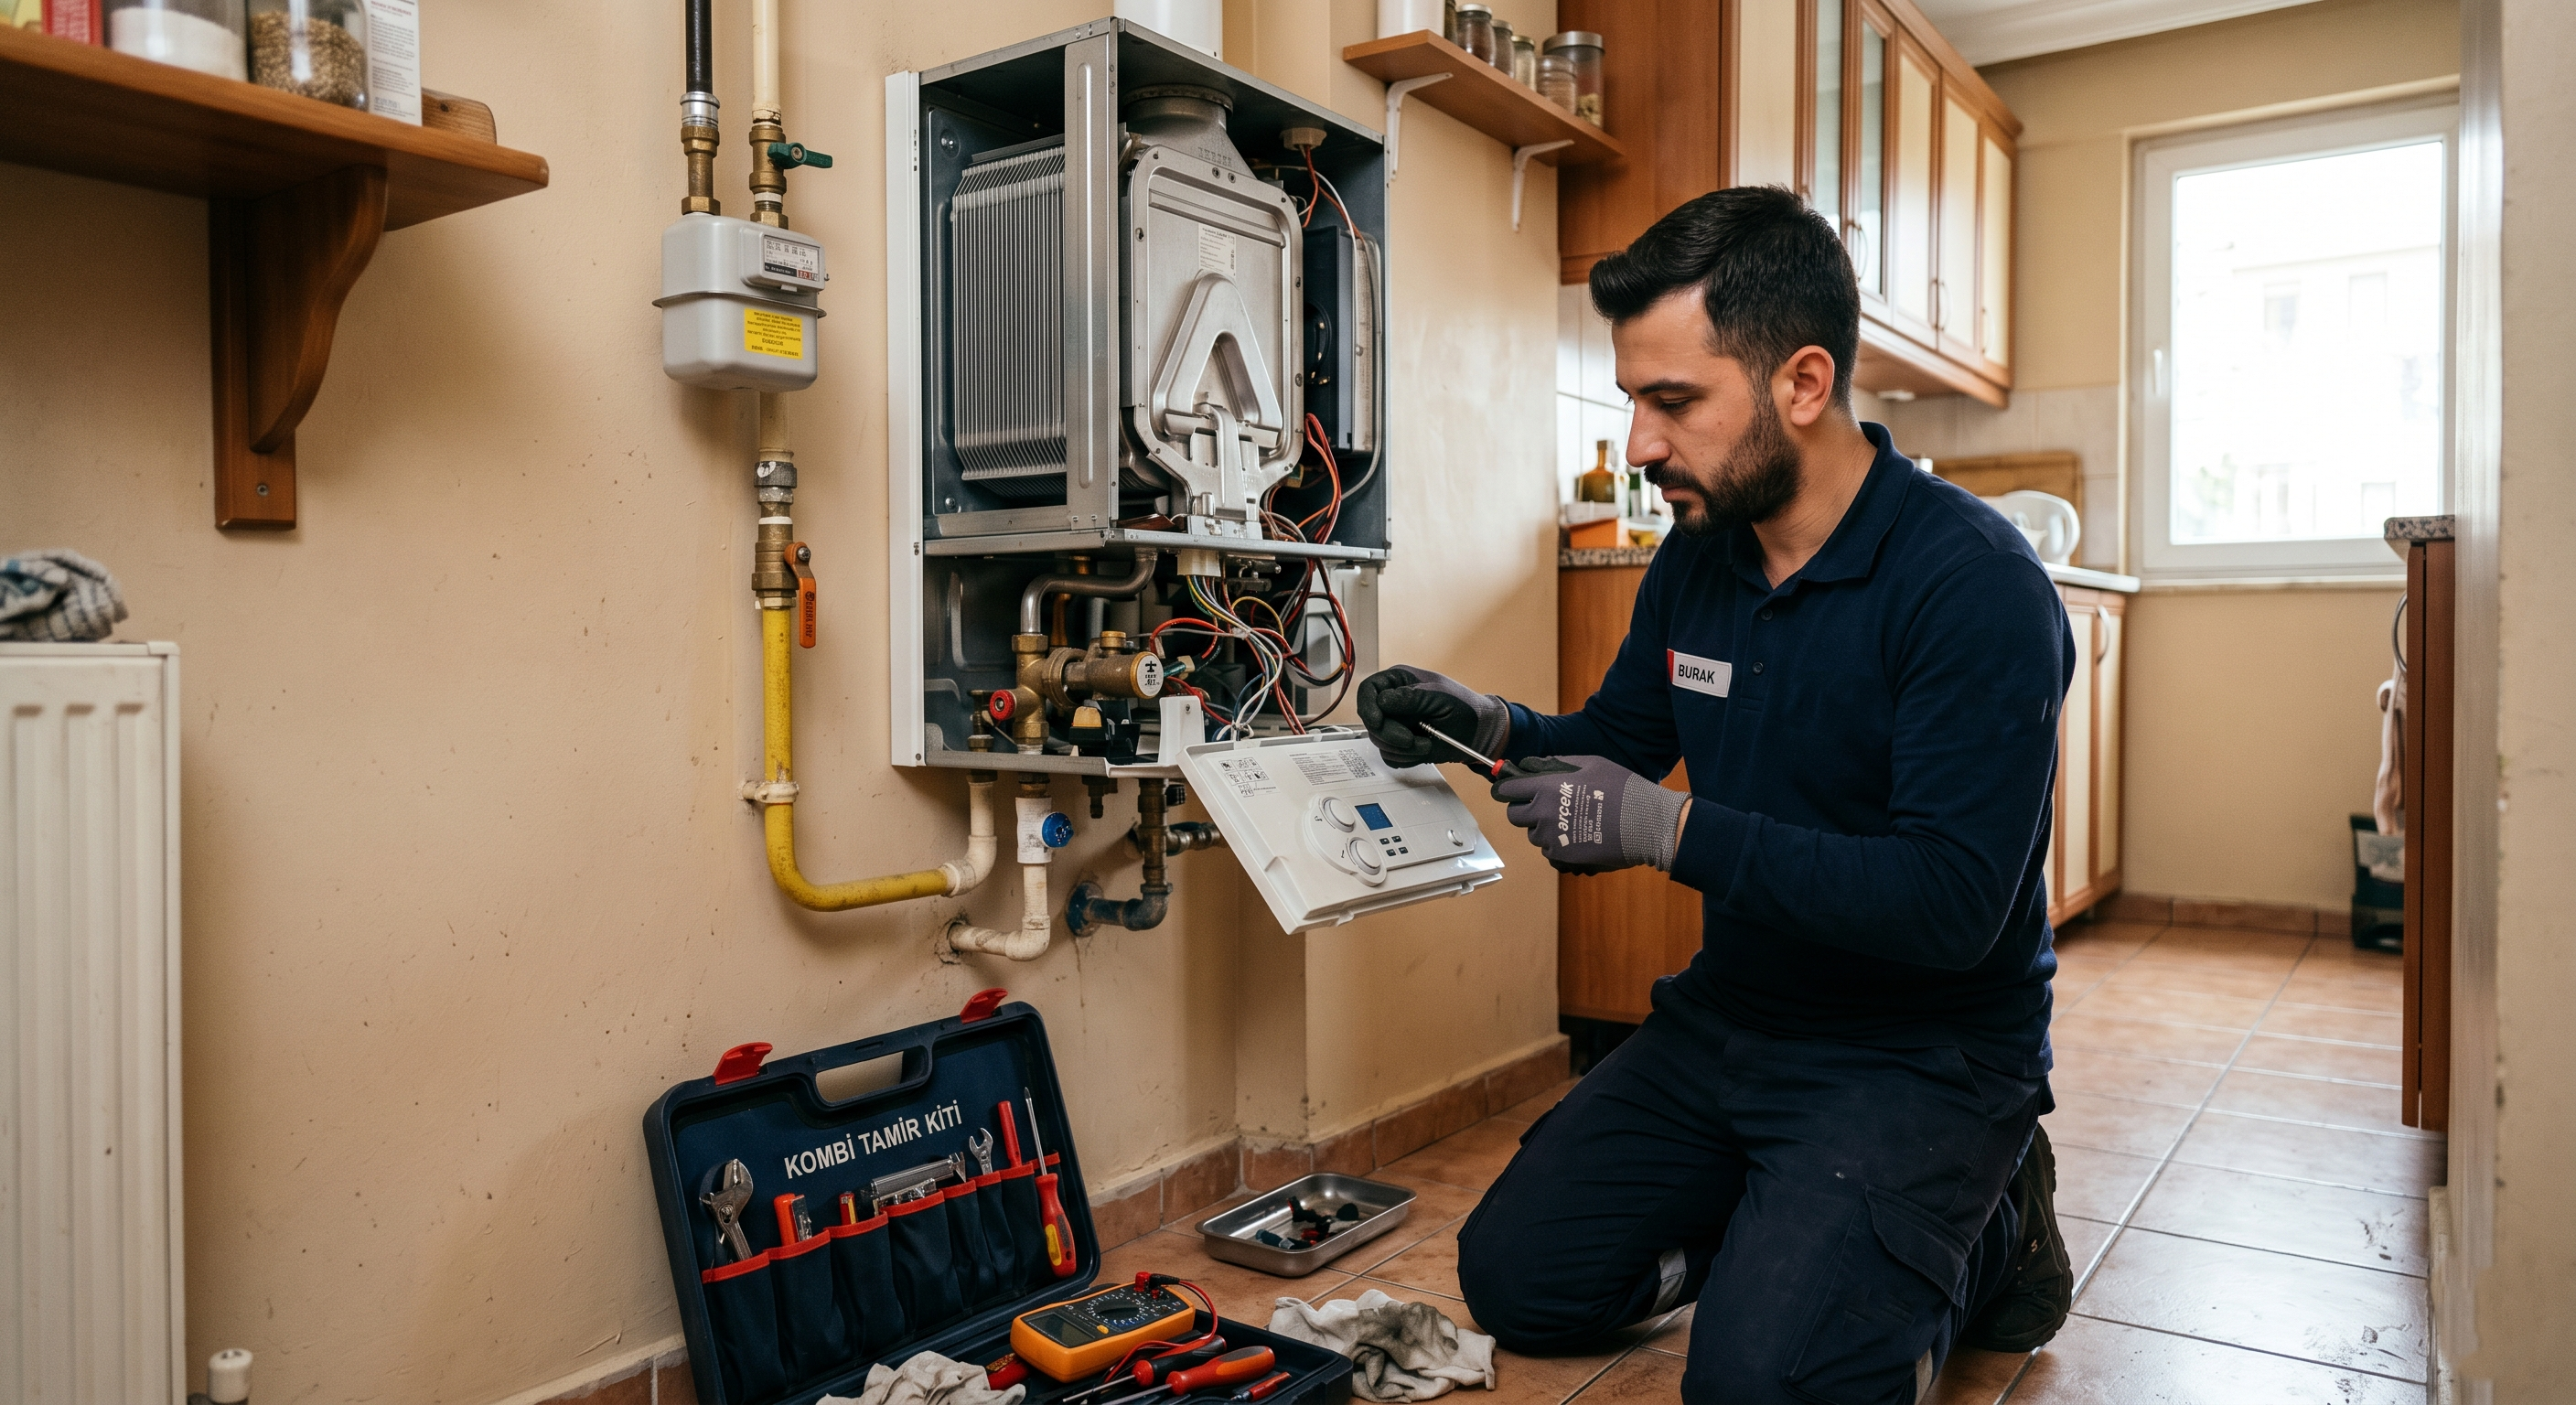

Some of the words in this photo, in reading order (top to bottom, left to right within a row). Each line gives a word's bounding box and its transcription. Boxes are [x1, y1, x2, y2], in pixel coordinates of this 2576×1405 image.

[1678, 663, 1715, 684] BURAK
[784, 1133, 855, 1179] KOMBİ
[858, 1116, 922, 1155] TAMİR
[925, 1099, 962, 1134] KİTİ
